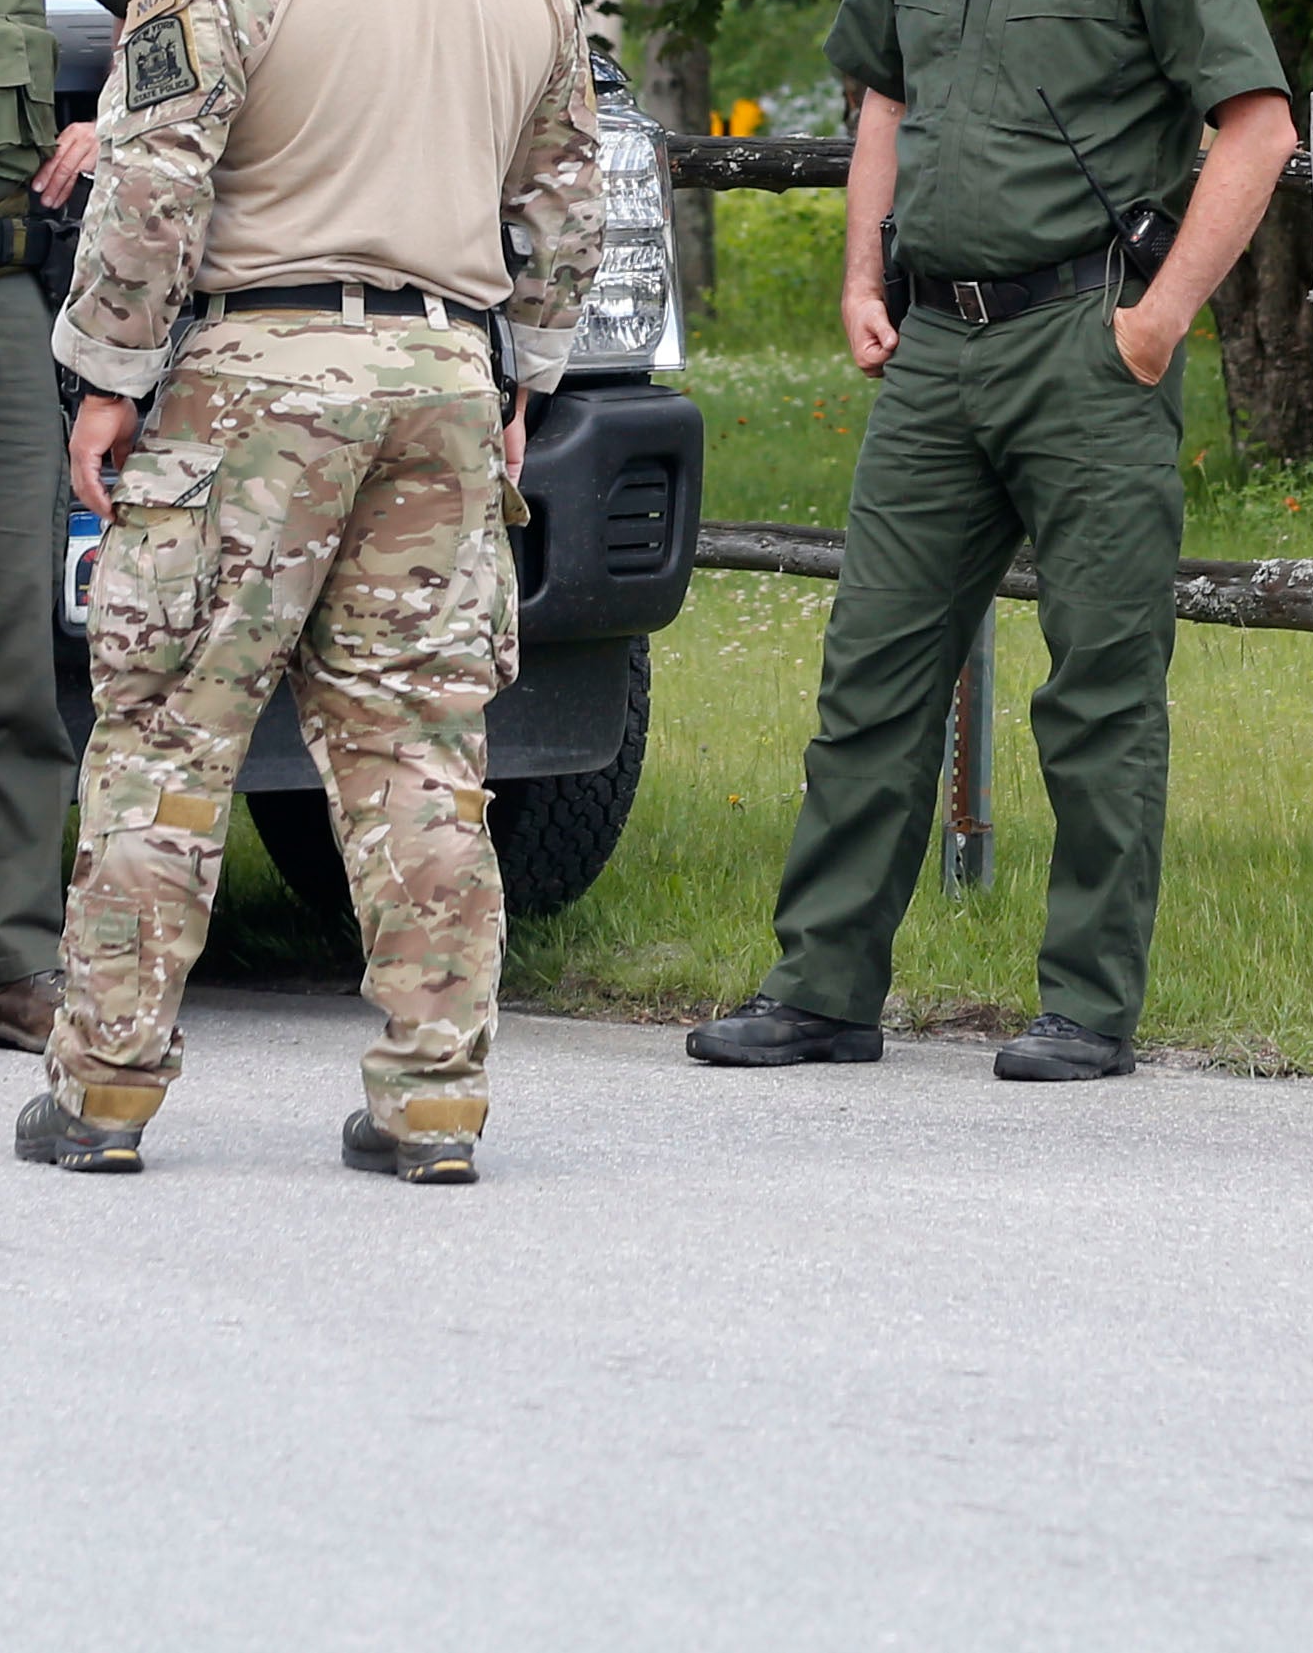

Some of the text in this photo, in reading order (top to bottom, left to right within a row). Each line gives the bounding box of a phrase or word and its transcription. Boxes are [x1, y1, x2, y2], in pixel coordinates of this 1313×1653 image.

[131, 20, 175, 45] NEW YORK
[133, 79, 189, 104] STATE POLICE
